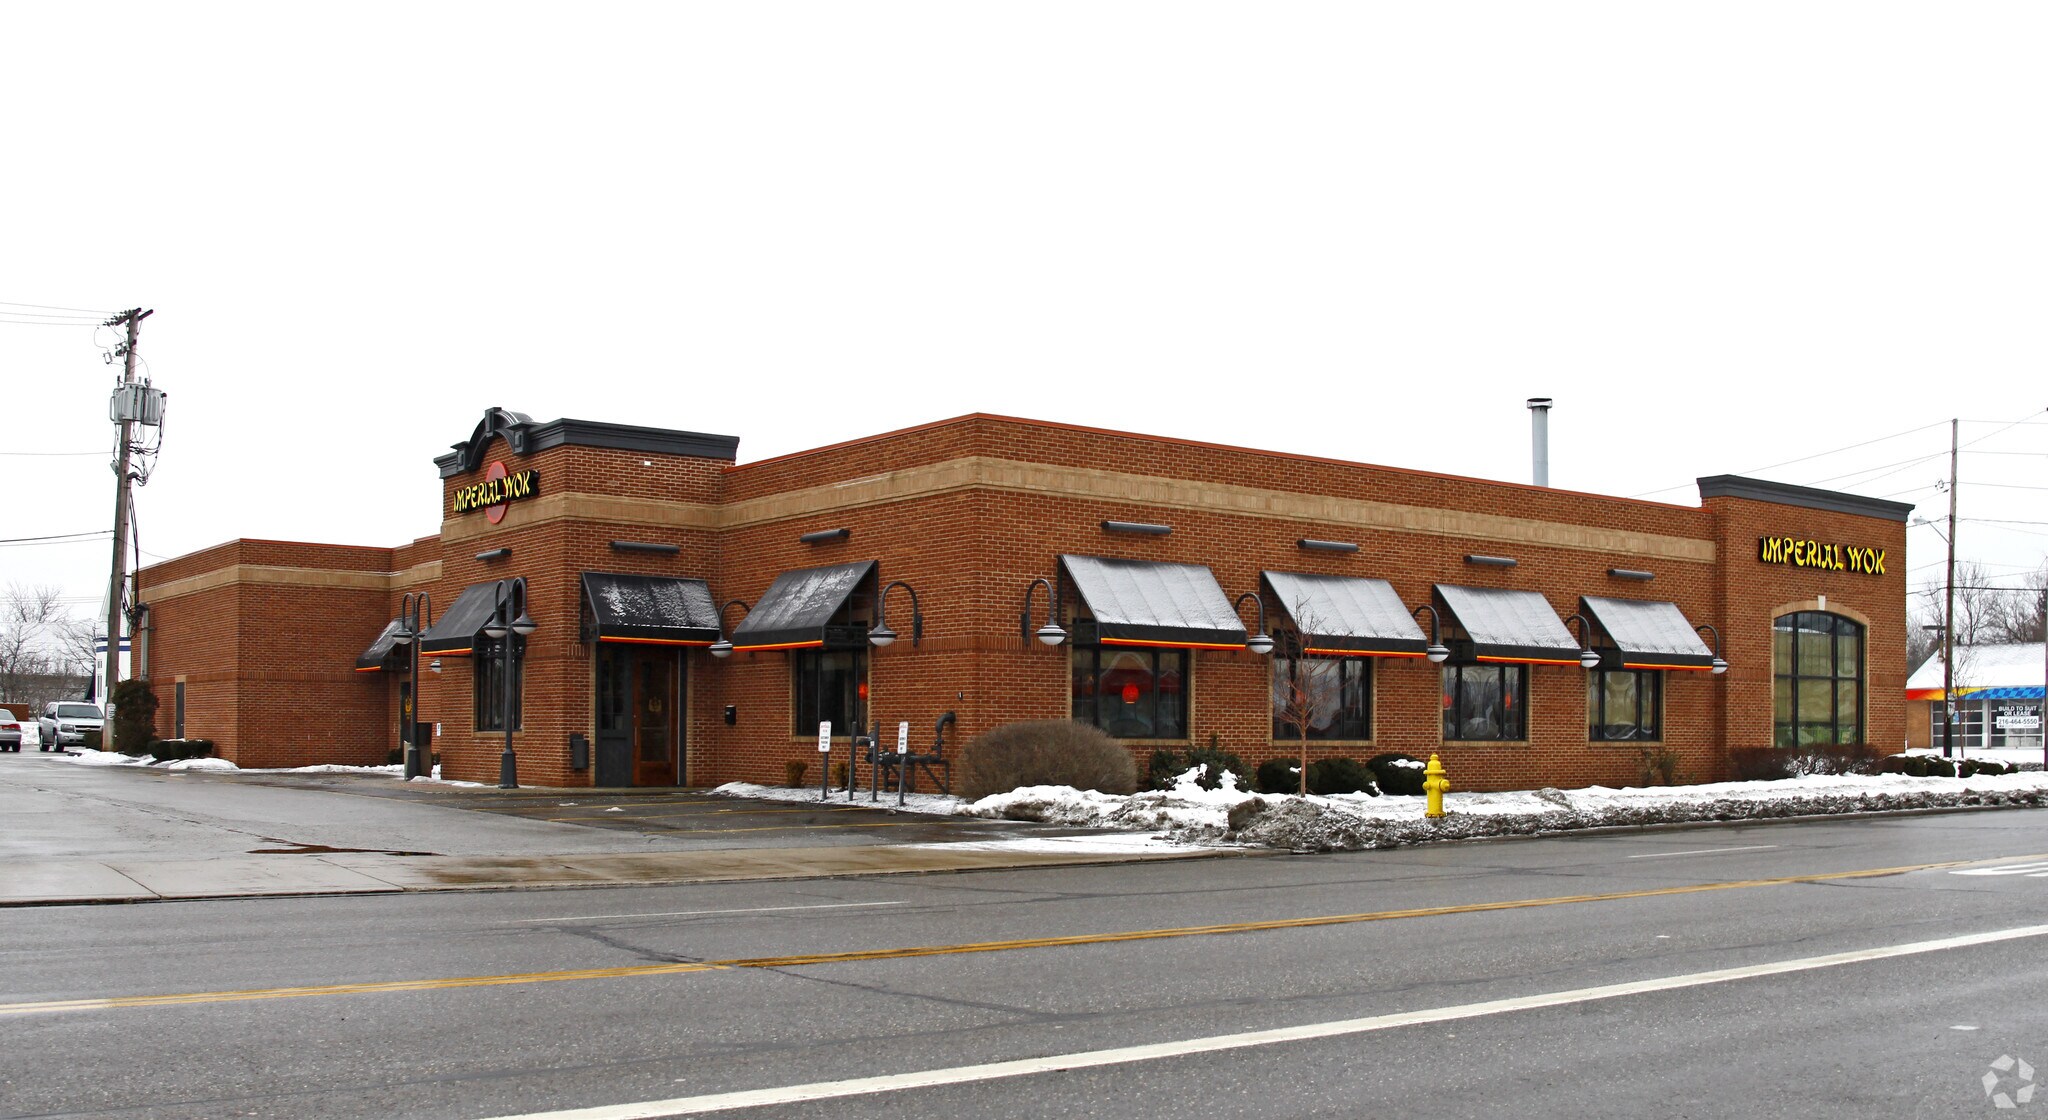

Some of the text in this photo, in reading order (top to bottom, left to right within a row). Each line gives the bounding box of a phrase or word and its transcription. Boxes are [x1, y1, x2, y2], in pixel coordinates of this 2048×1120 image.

[453, 470, 531, 512] IMPERIAL WOK
[1762, 536, 1886, 575] IMPERIAL WOK
